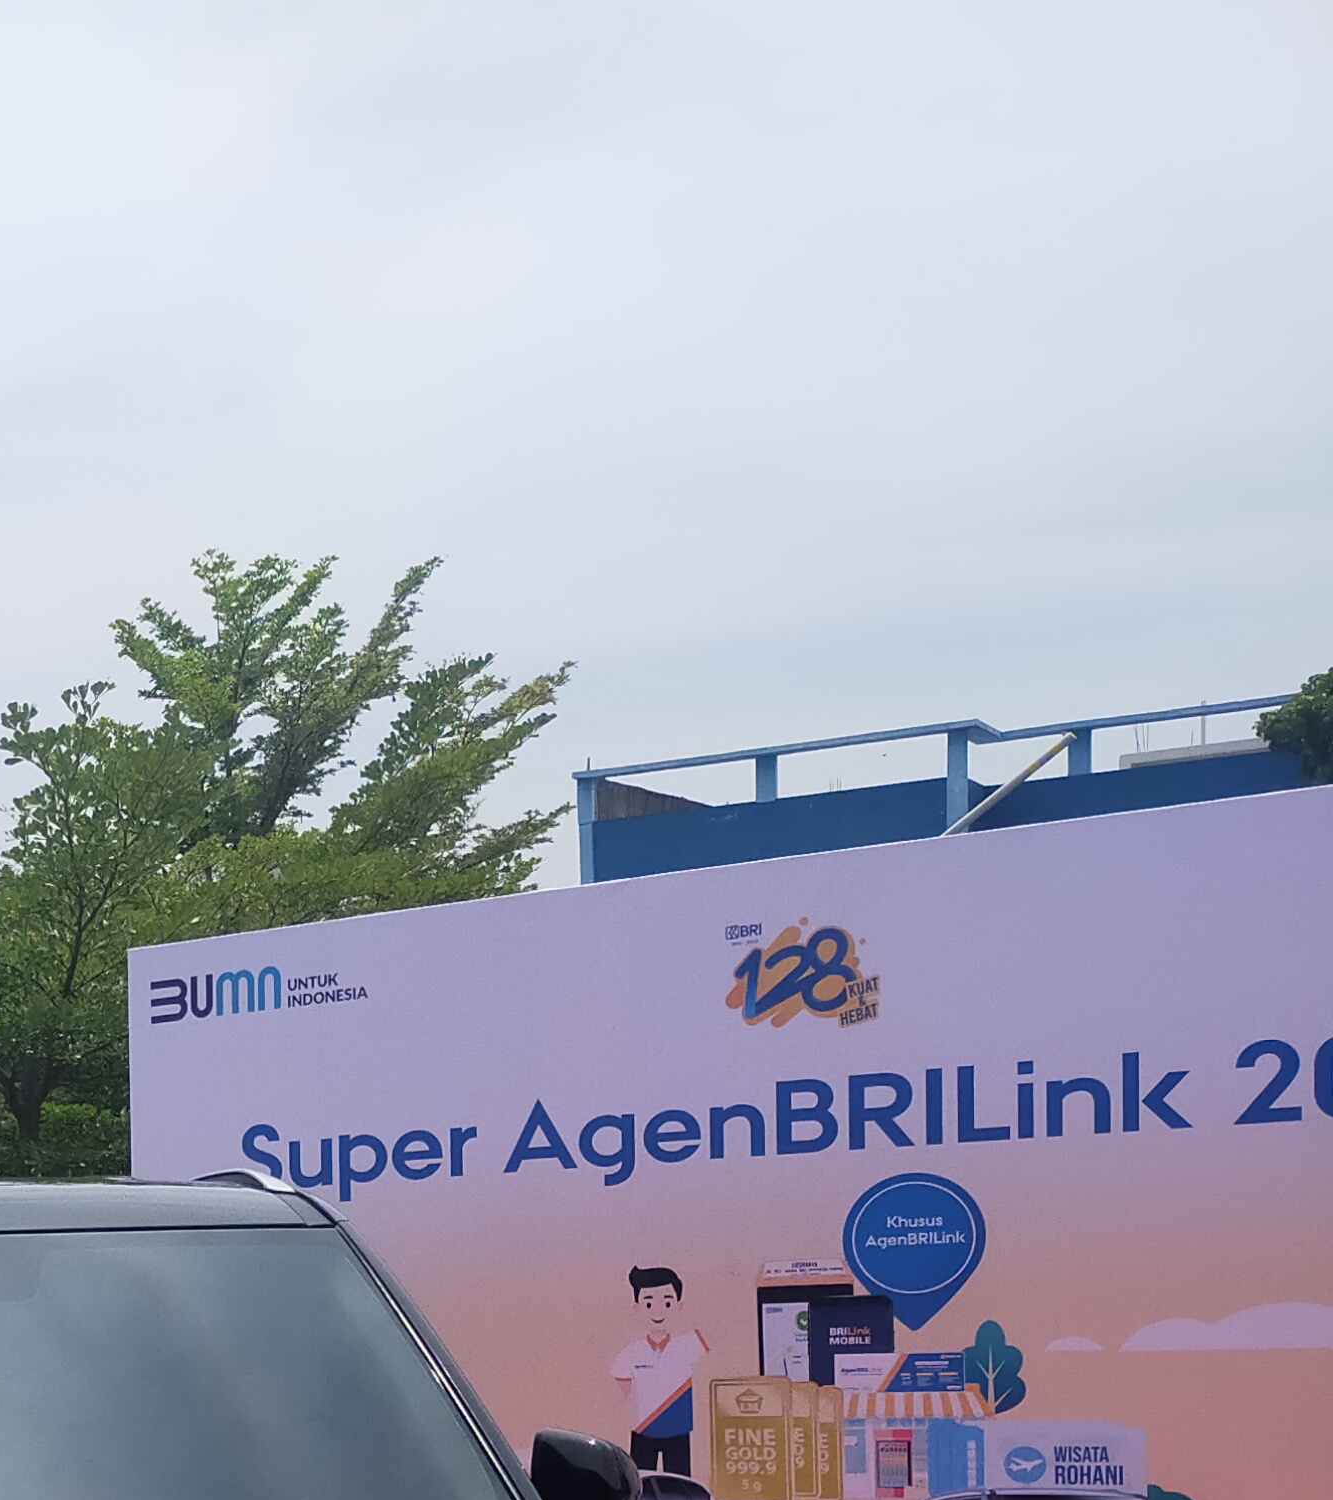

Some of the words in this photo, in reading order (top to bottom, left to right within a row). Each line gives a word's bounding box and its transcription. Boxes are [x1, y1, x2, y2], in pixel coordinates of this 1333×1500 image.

[740, 923, 762, 938] BRI
[287, 972, 339, 992] UNTUK
[734, 927, 857, 1020] 128
[150, 966, 281, 1024] BUMN
[287, 986, 369, 1008] INDONESIA
[848, 977, 879, 998] KUAT
[839, 1003, 878, 1026] HEBAT
[241, 1123, 478, 1202] Super
[503, 1051, 1193, 1187] AgenBRILink
[1234, 1036, 1333, 1126] 2
[885, 1214, 943, 1229] Khusus
[864, 1230, 966, 1250] AgenBRILink
[829, 1326, 871, 1337] BRILink
[829, 1336, 872, 1345] MOBILE
[724, 1428, 776, 1446] FINE
[725, 1446, 777, 1461] GOLD
[1053, 1446, 1110, 1463] WISATA
[725, 1461, 777, 1475] 999.9
[1054, 1465, 1124, 1486] ROHANI
[741, 1479, 750, 1490] 5
